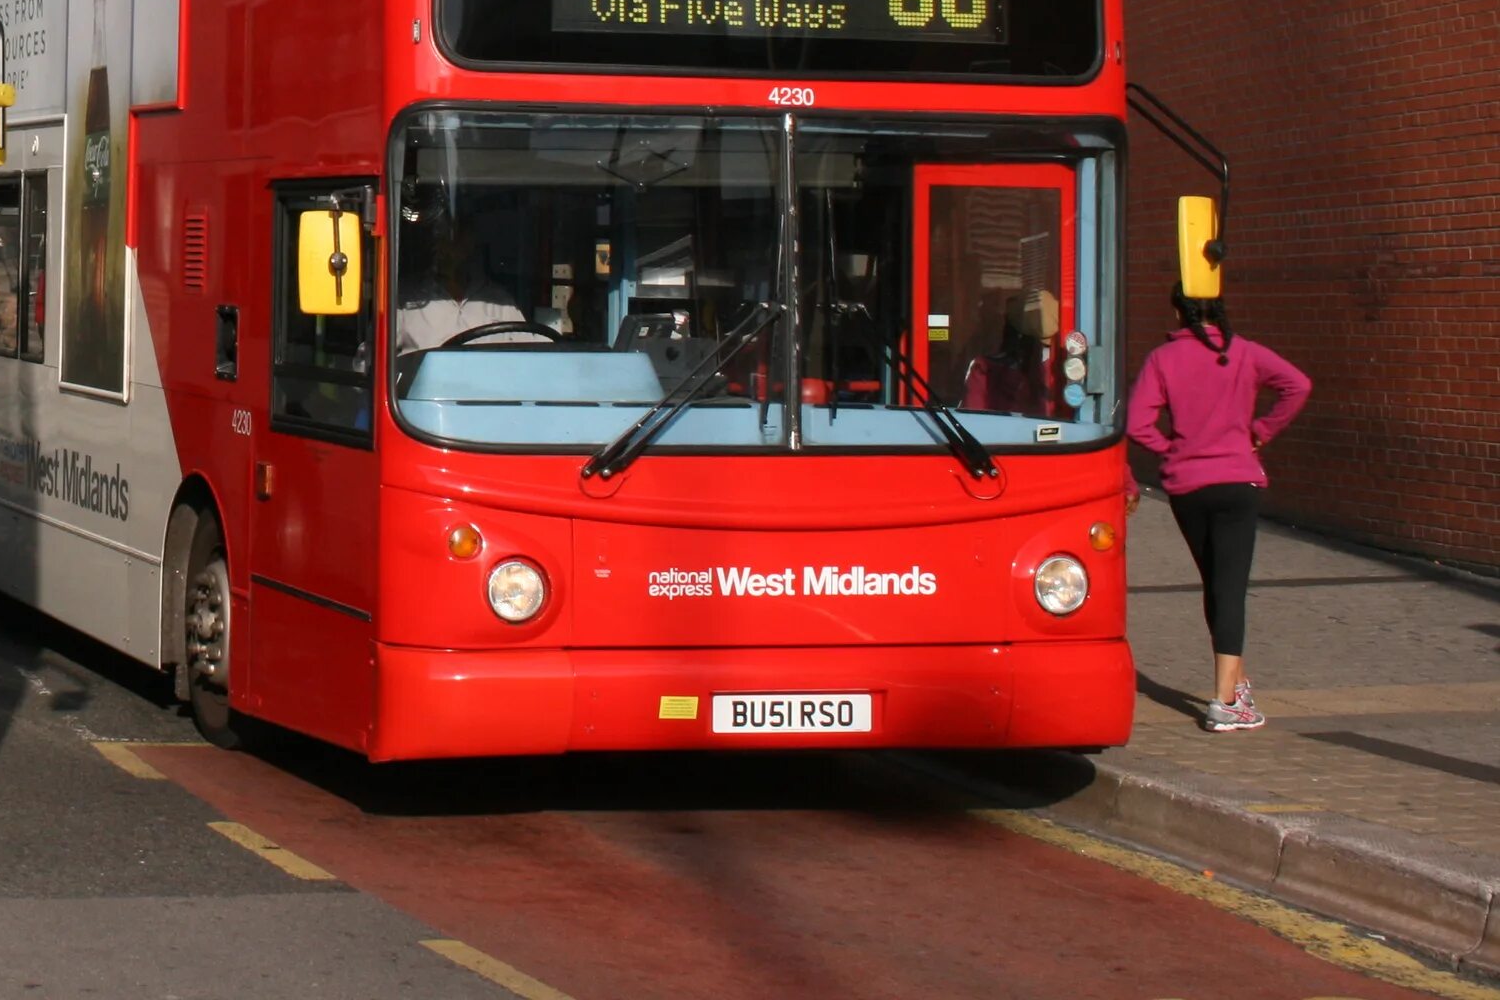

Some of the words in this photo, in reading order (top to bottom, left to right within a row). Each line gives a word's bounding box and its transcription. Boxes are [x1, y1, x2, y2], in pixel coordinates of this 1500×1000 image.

[4, 29, 46, 61] OURCES
[768, 87, 815, 106] 4230
[232, 409, 252, 436] 4230
[26, 439, 60, 499] West
[62, 448, 129, 522] Midlands
[648, 583, 713, 600] express
[649, 567, 712, 584] national
[716, 566, 795, 597] West
[803, 565, 937, 596] Midlands
[731, 700, 792, 728] BU51
[800, 699, 854, 728] RSO
